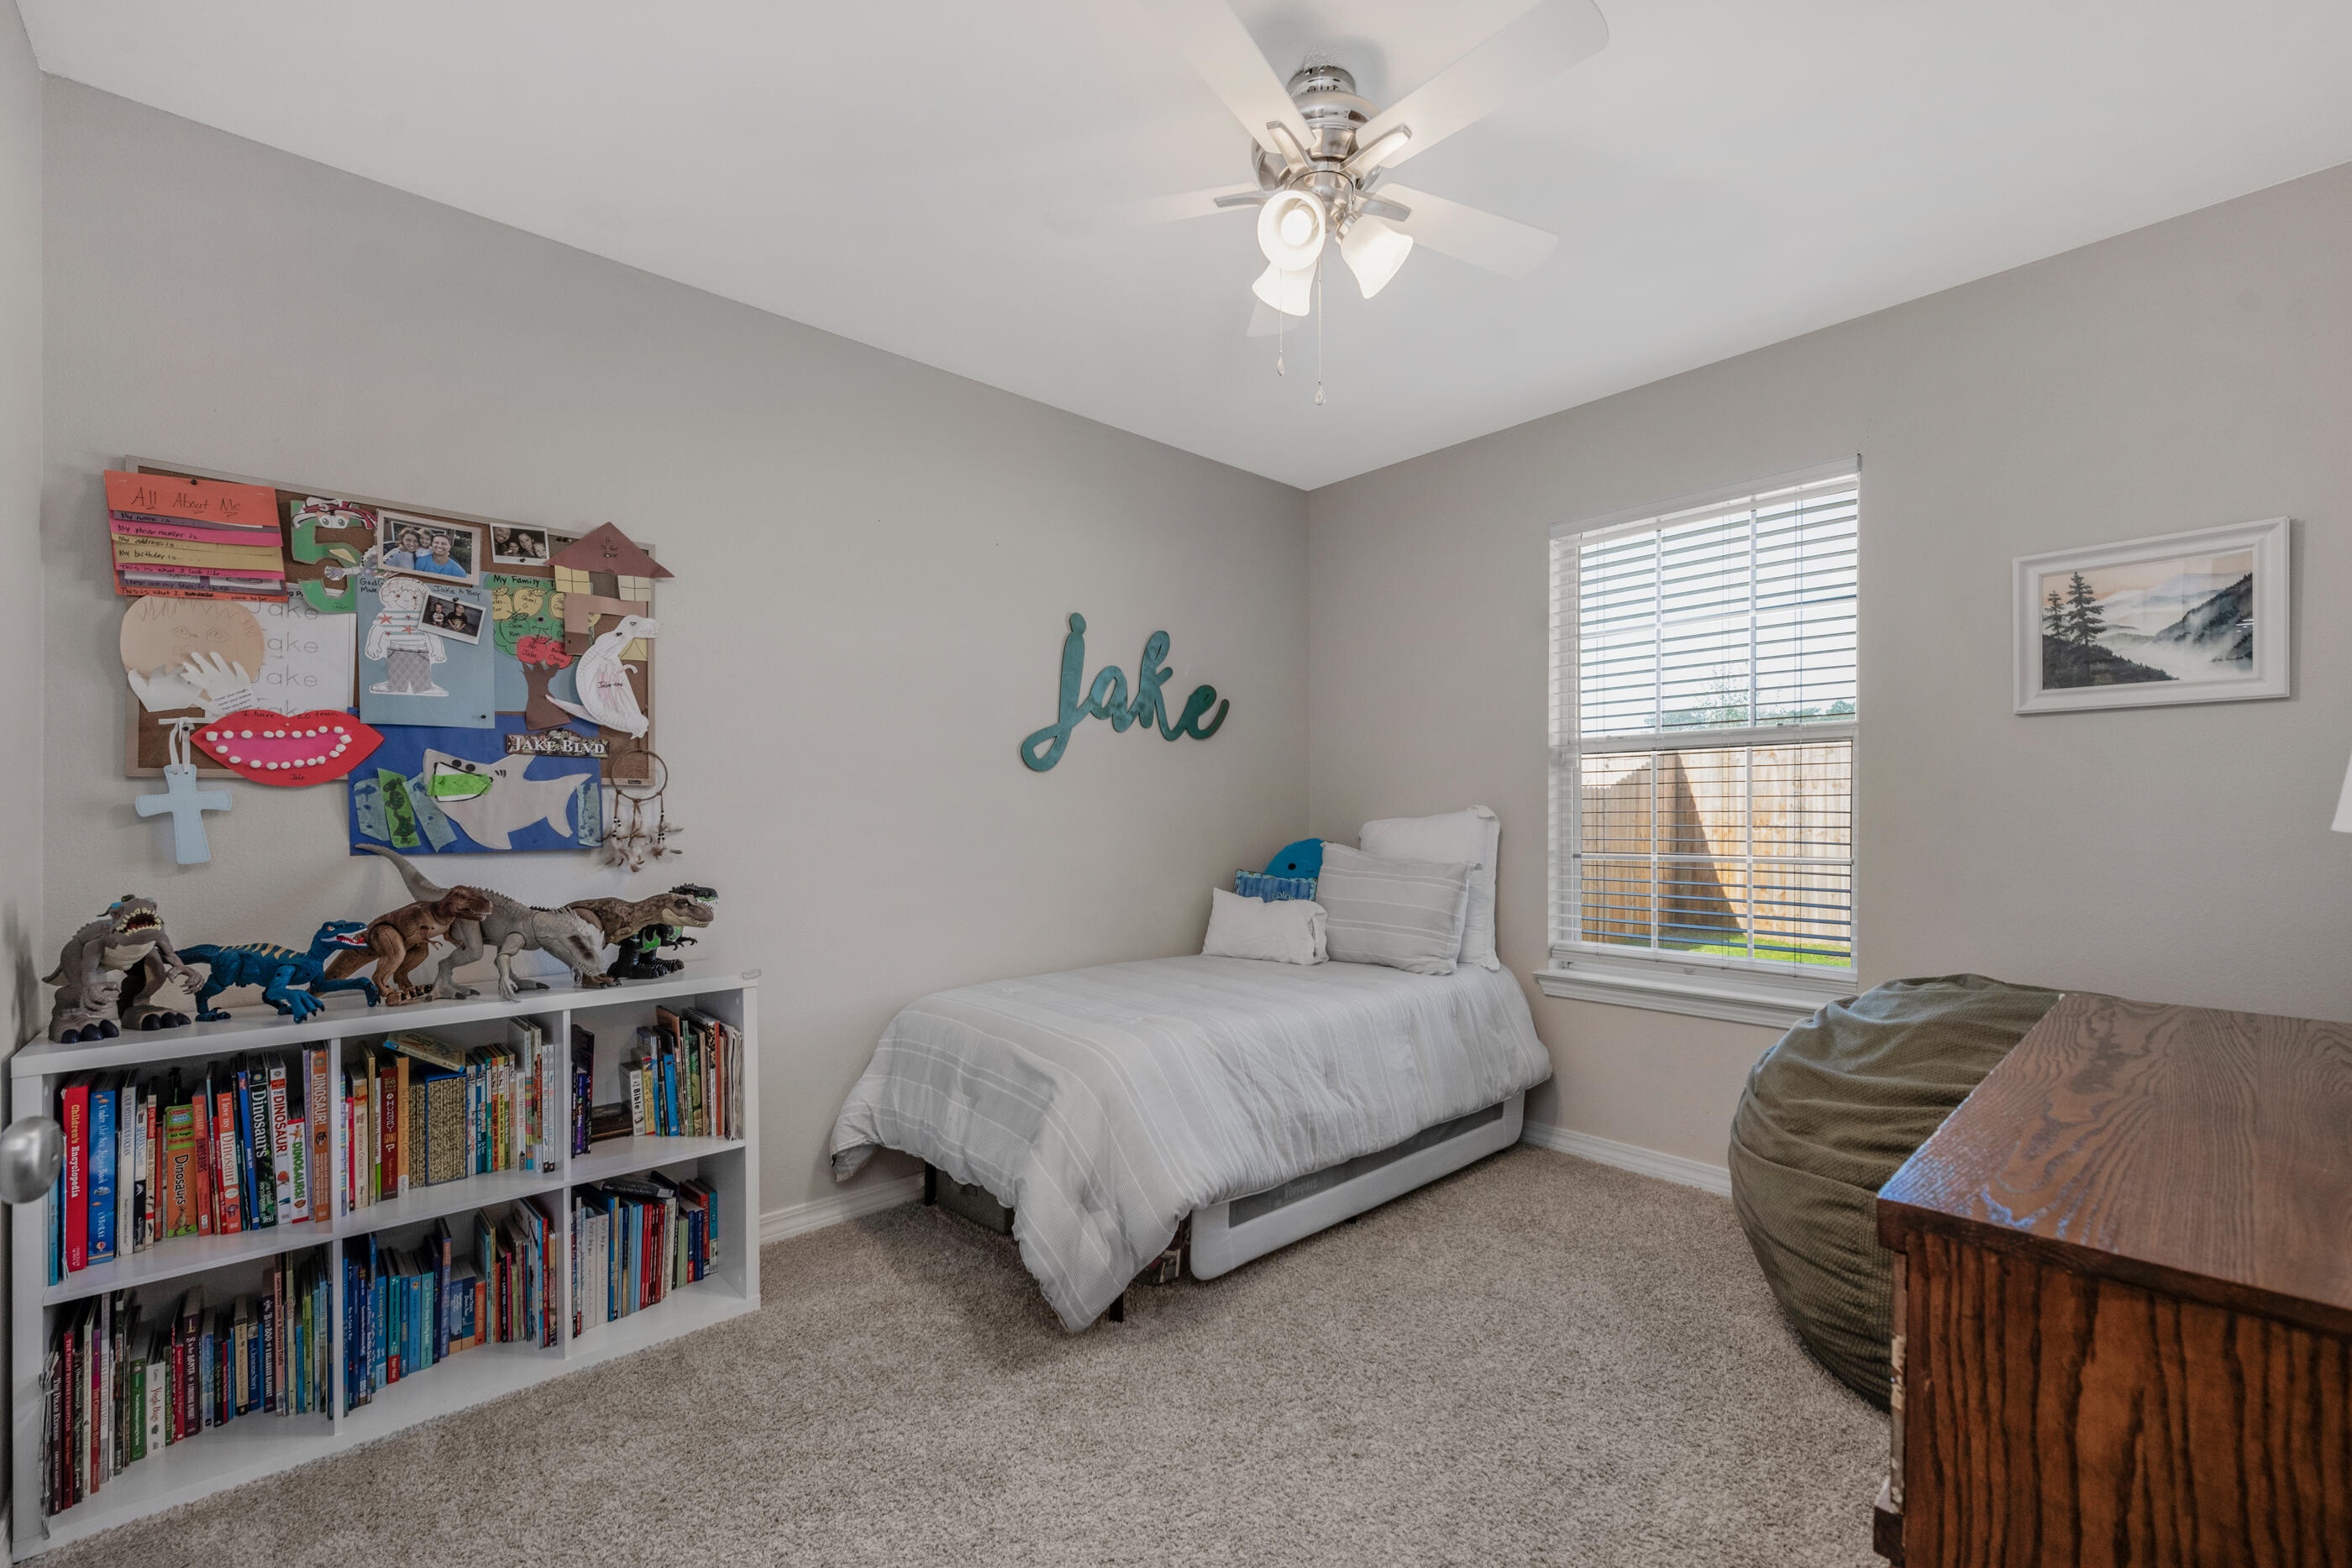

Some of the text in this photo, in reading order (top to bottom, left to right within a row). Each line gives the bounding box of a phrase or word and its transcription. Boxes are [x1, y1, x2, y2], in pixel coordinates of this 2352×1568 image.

[131, 486, 243, 512] All About Me
[135, 526, 157, 535] phone
[158, 530, 184, 538] number
[134, 550, 165, 560] birthday
[493, 574, 507, 585] My
[511, 575, 540, 588] Family
[433, 585, 455, 595] Jake
[465, 588, 480, 602] Boy
[1021, 612, 1231, 772] jake
[254, 711, 275, 719] have
[514, 737, 606, 754] JAKE BLVD
[313, 1072, 327, 1125] DINOSAUR!
[97, 1105, 108, 1124] Under
[222, 1103, 231, 1116] love
[386, 1100, 395, 1132] HUNGRY
[222, 1118, 231, 1128] my
[251, 1089, 268, 1158] Dinosaurs
[274, 1095, 287, 1153] DINOSAUR
[70, 1104, 80, 1198] Children's Encyclopedia
[197, 1137, 207, 1173] DINOSAURS
[222, 1134, 236, 1183] Dinosaur
[97, 1168, 106, 1183] Book
[146, 1167, 155, 1191] Dolphins
[174, 1154, 189, 1205] Dinosaurs
[292, 1141, 305, 1198] DINOSAURS!
[53, 1377, 61, 1392] THE
[249, 1375, 258, 1390] Story
